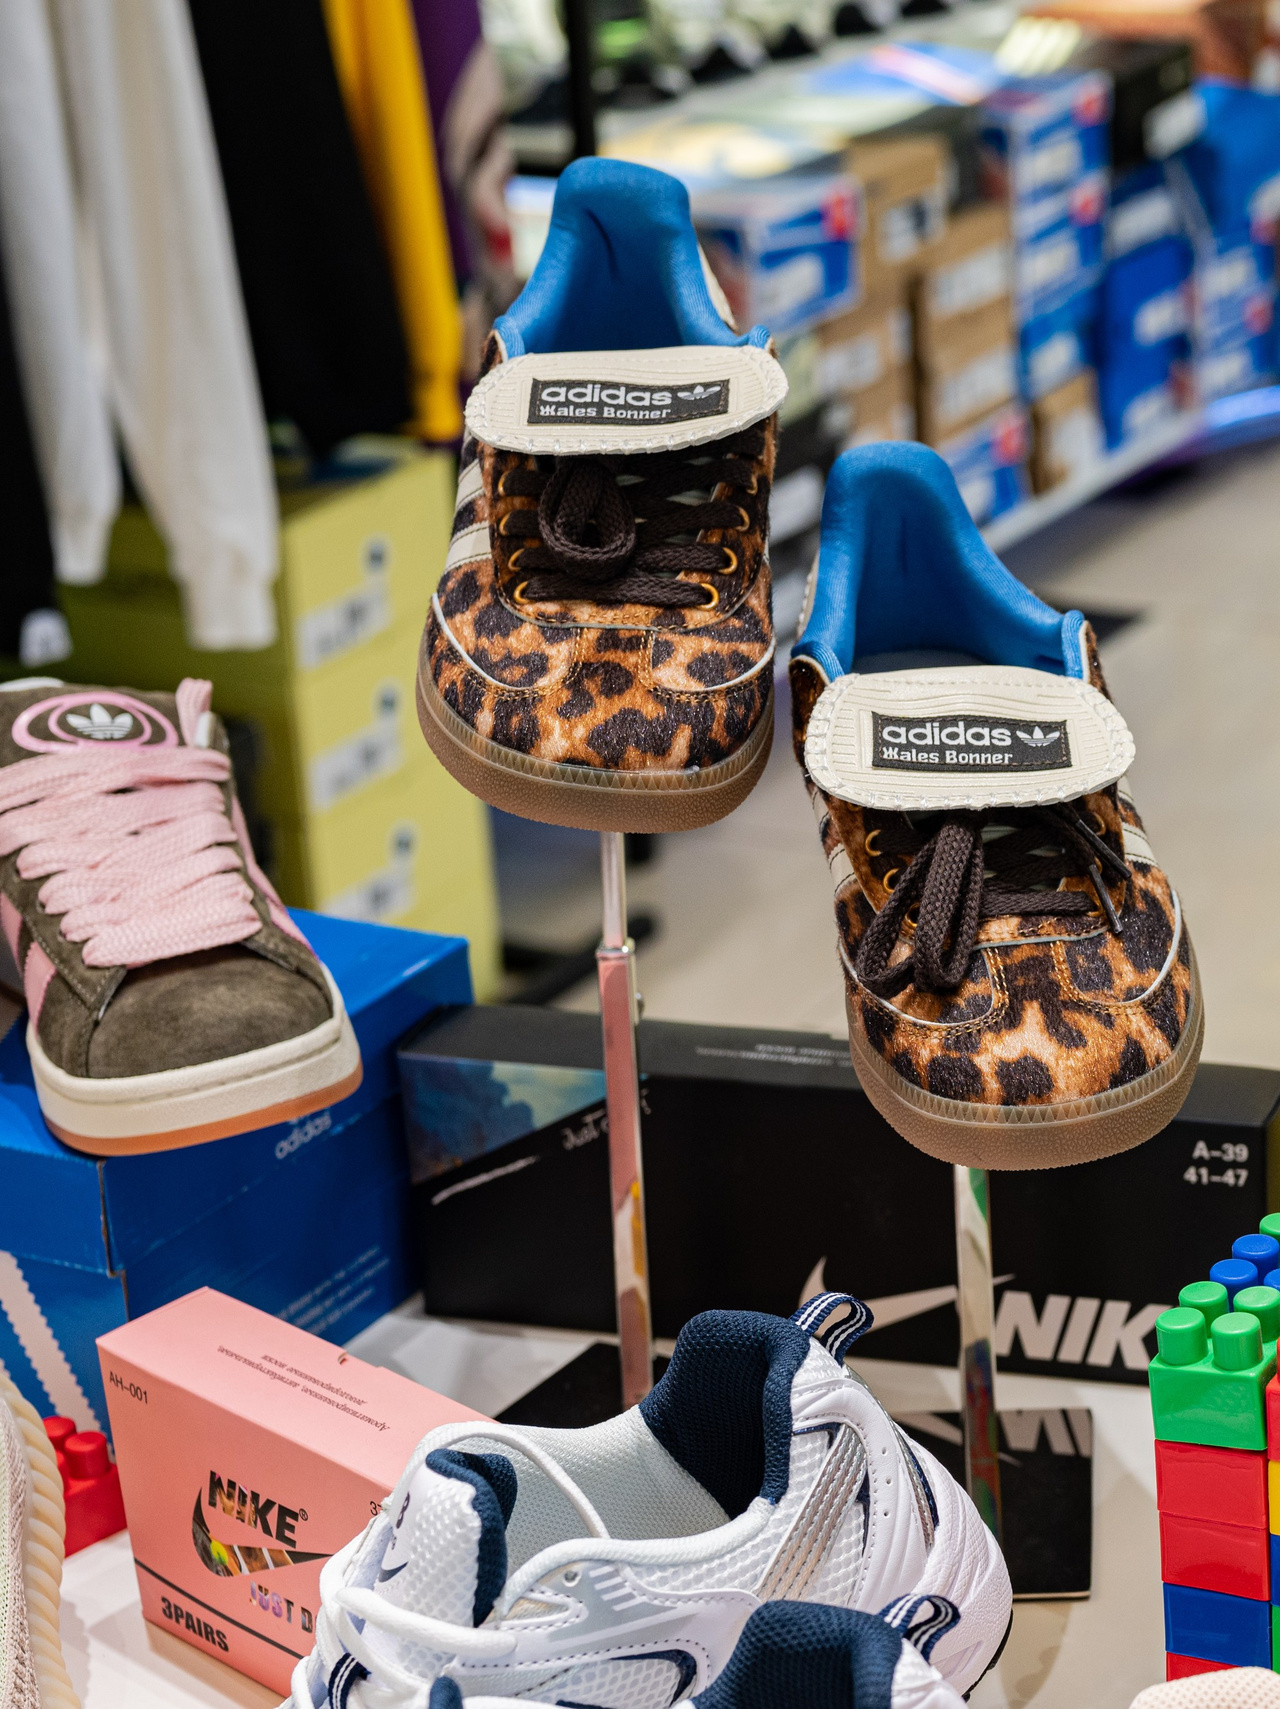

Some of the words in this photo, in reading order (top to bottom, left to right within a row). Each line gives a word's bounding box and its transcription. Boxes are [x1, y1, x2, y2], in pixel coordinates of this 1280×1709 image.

[540, 384, 672, 406] adidas
[603, 406, 671, 419] Bonner
[881, 722, 1013, 746] adidas
[945, 749, 1014, 765] Bonner
[275, 1108, 332, 1160] adidas
[995, 1289, 1173, 1372] NIK
[161, 1595, 230, 1653] 3PAIRS
[249, 1580, 295, 1624] JUST
[300, 1606, 317, 1634] D
